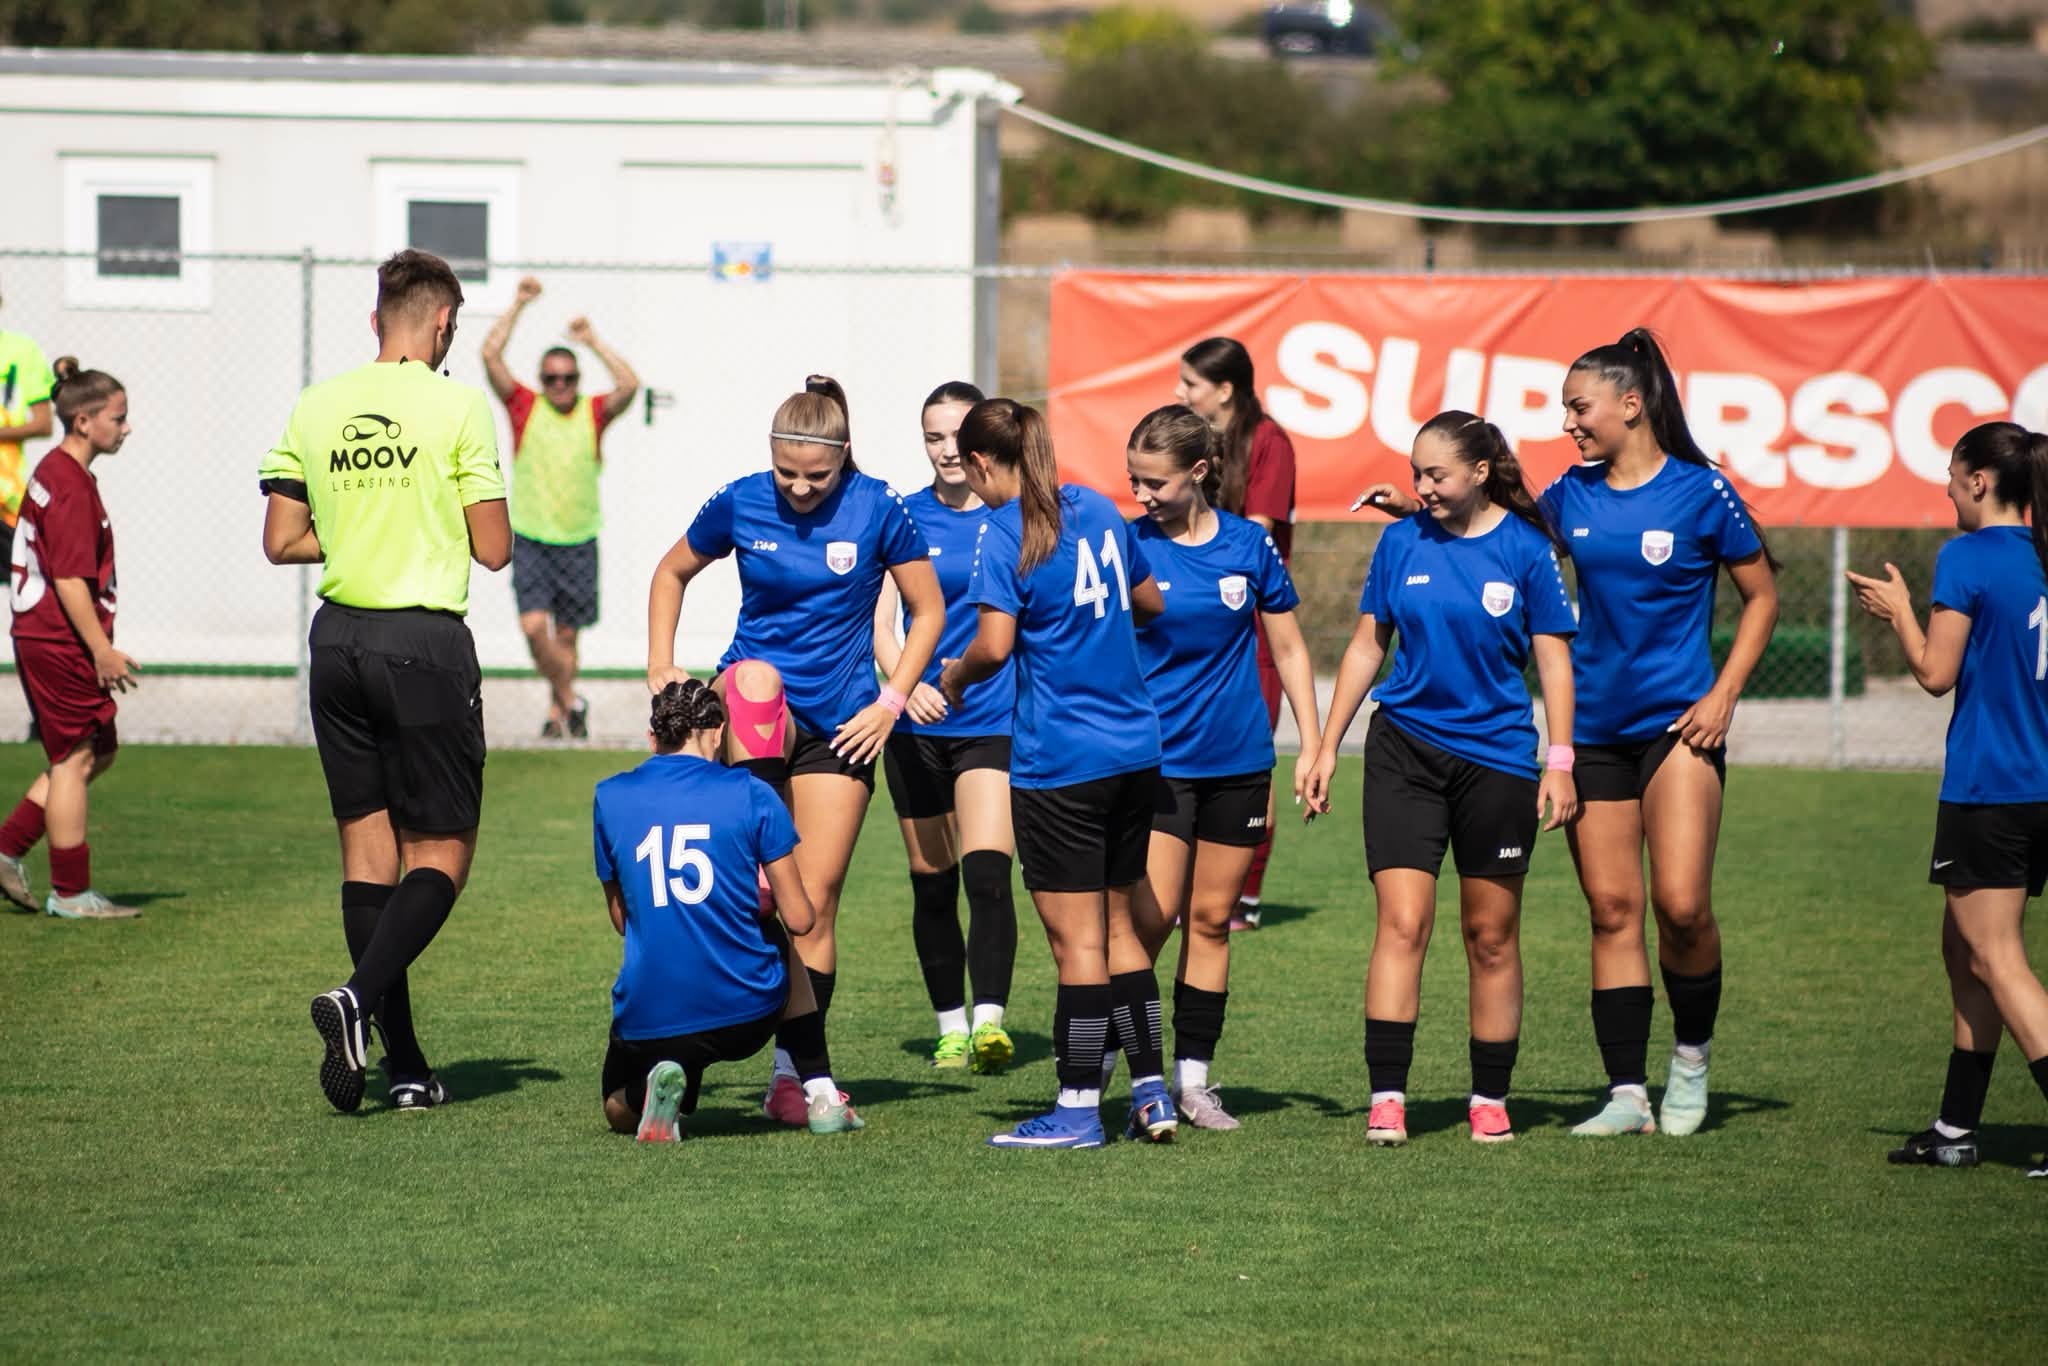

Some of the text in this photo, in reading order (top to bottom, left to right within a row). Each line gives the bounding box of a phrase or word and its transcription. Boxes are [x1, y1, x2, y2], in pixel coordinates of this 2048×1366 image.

[1264, 320, 2048, 491] SUPRSC
[330, 446, 418, 473] MOOV
[332, 476, 411, 492] LEASING
[1073, 528, 1130, 619] 41
[1406, 574, 1430, 586] JAKO
[636, 823, 714, 908] 15
